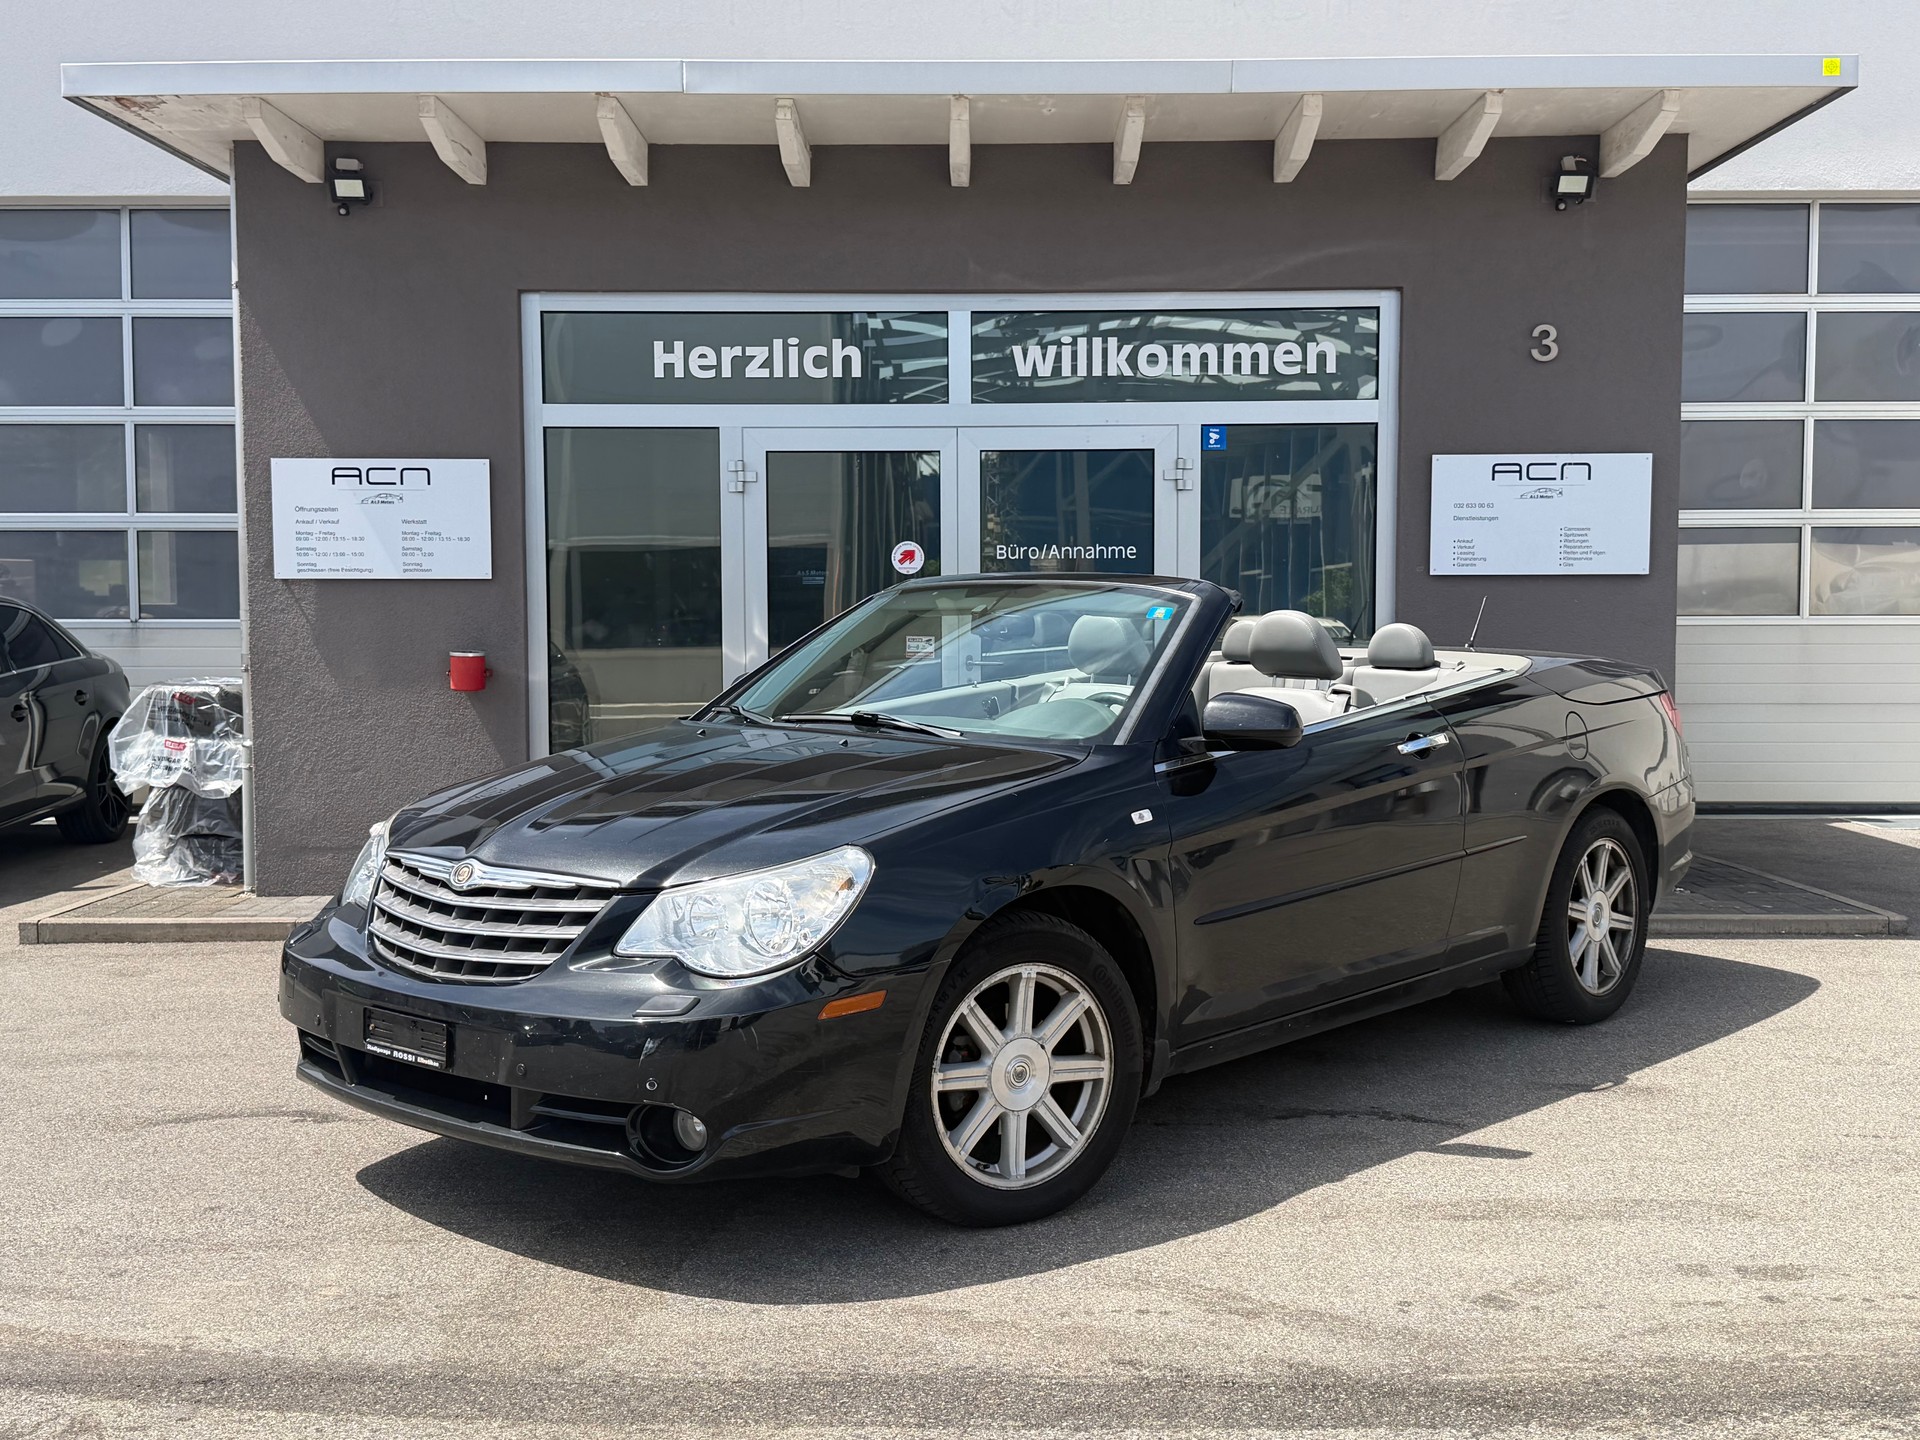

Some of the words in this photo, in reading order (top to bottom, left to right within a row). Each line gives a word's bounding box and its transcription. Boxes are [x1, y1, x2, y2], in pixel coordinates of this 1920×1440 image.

[1530, 324, 1559, 362] 3
[652, 338, 863, 379] Herzlich
[1010, 337, 1338, 377] willkommen
[294, 505, 339, 513] Öffnungszeiten
[996, 543, 1137, 560] Büro/Annahme
[393, 1050, 415, 1062] ROSSI
